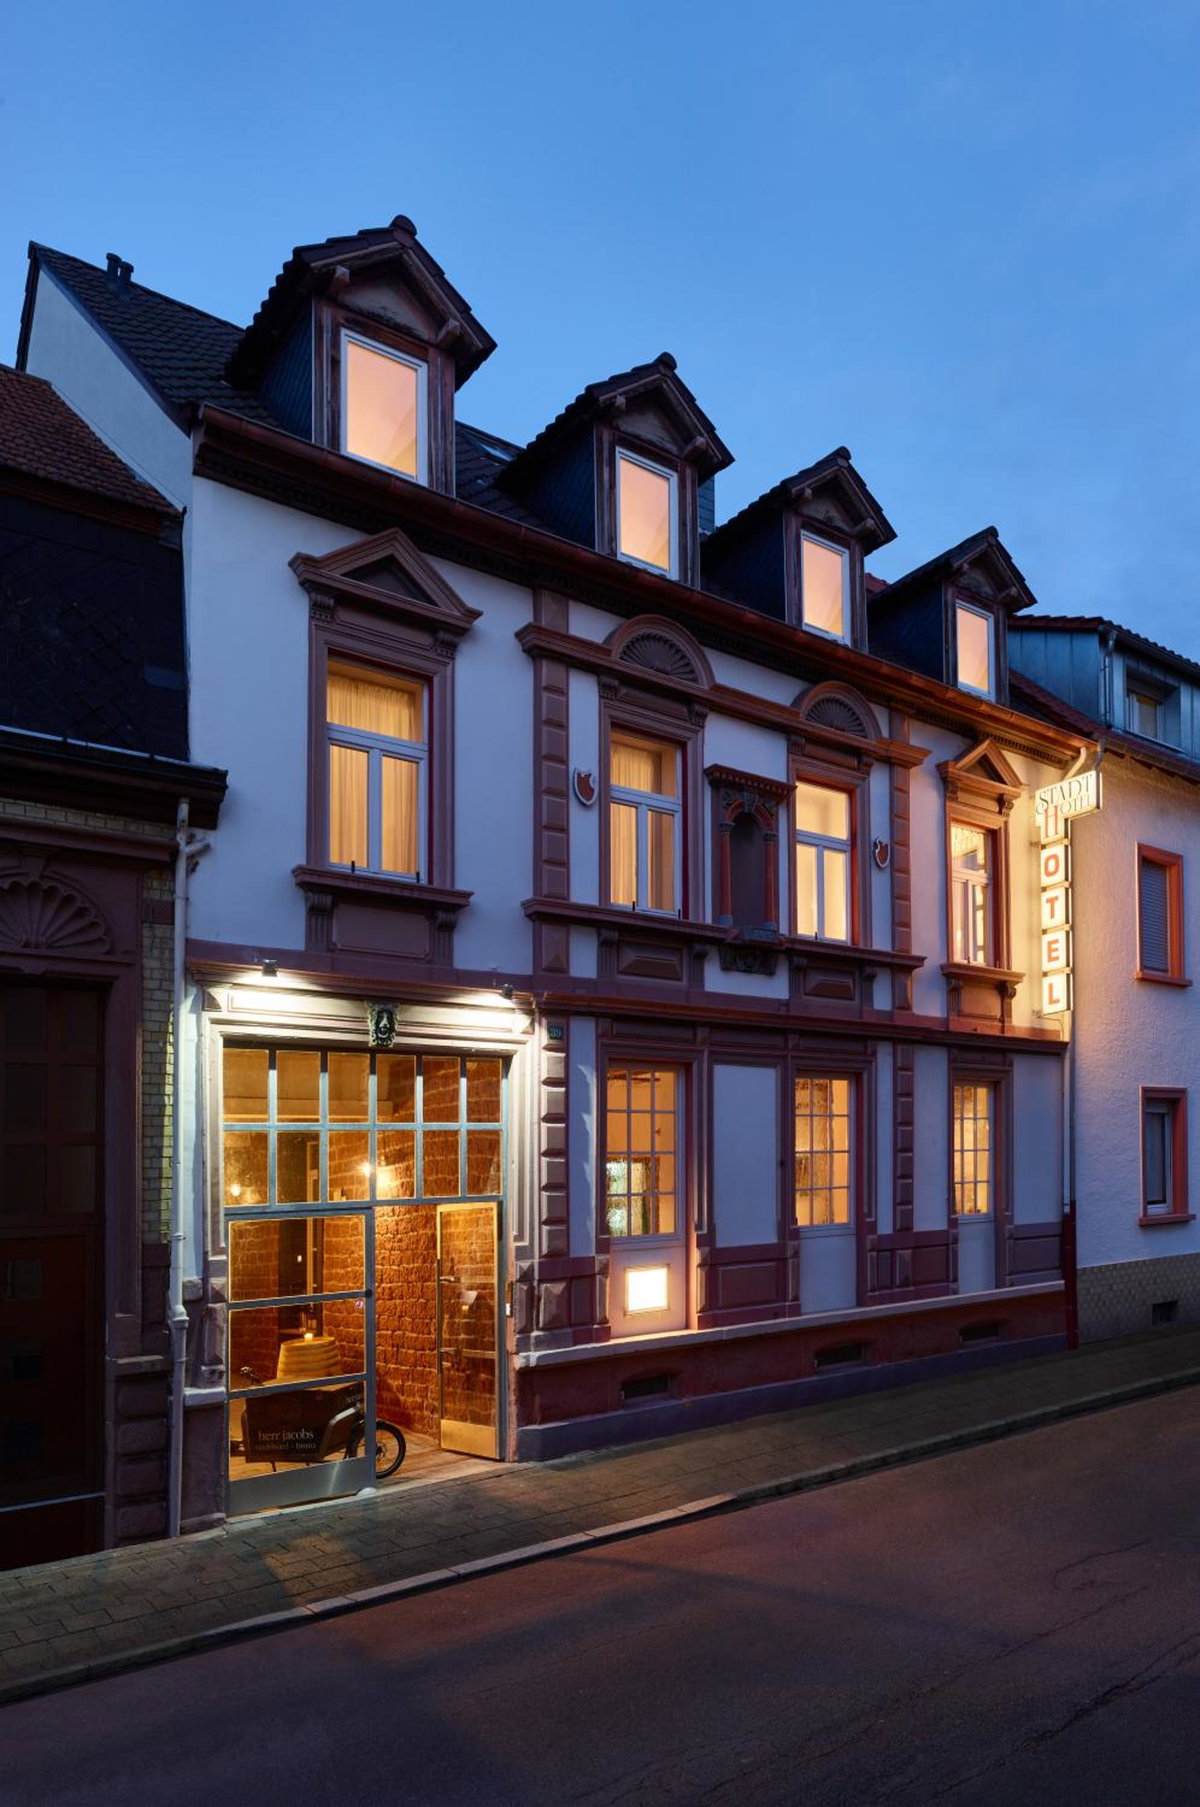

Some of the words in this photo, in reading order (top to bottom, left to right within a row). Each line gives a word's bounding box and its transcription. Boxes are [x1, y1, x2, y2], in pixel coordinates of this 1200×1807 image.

[1039, 774, 1092, 809] STADT
[1044, 805, 1061, 1006] HOTEL
[282, 1428, 314, 1442] jacobs
